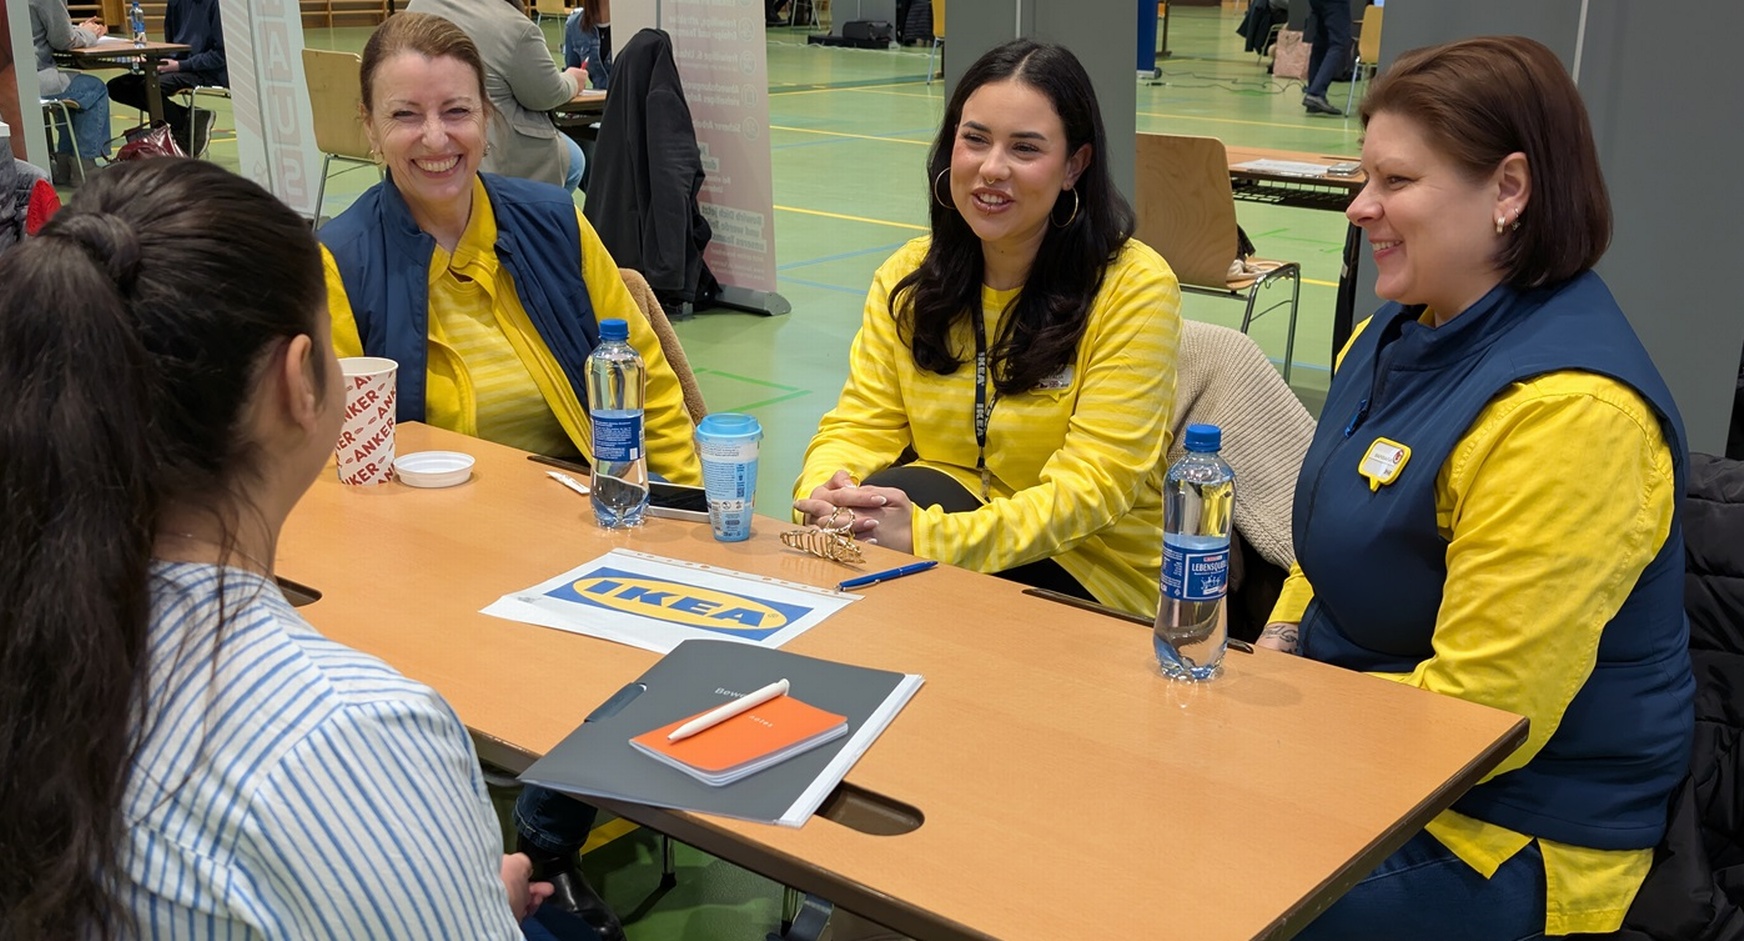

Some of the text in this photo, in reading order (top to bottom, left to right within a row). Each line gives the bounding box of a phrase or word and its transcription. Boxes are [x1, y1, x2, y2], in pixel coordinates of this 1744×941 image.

[977, 352, 985, 385] IKEA
[976, 403, 984, 437] IKEA
[354, 417, 394, 462] ANKER
[584, 579, 763, 628] IKEA
[748, 715, 773, 728] notes
